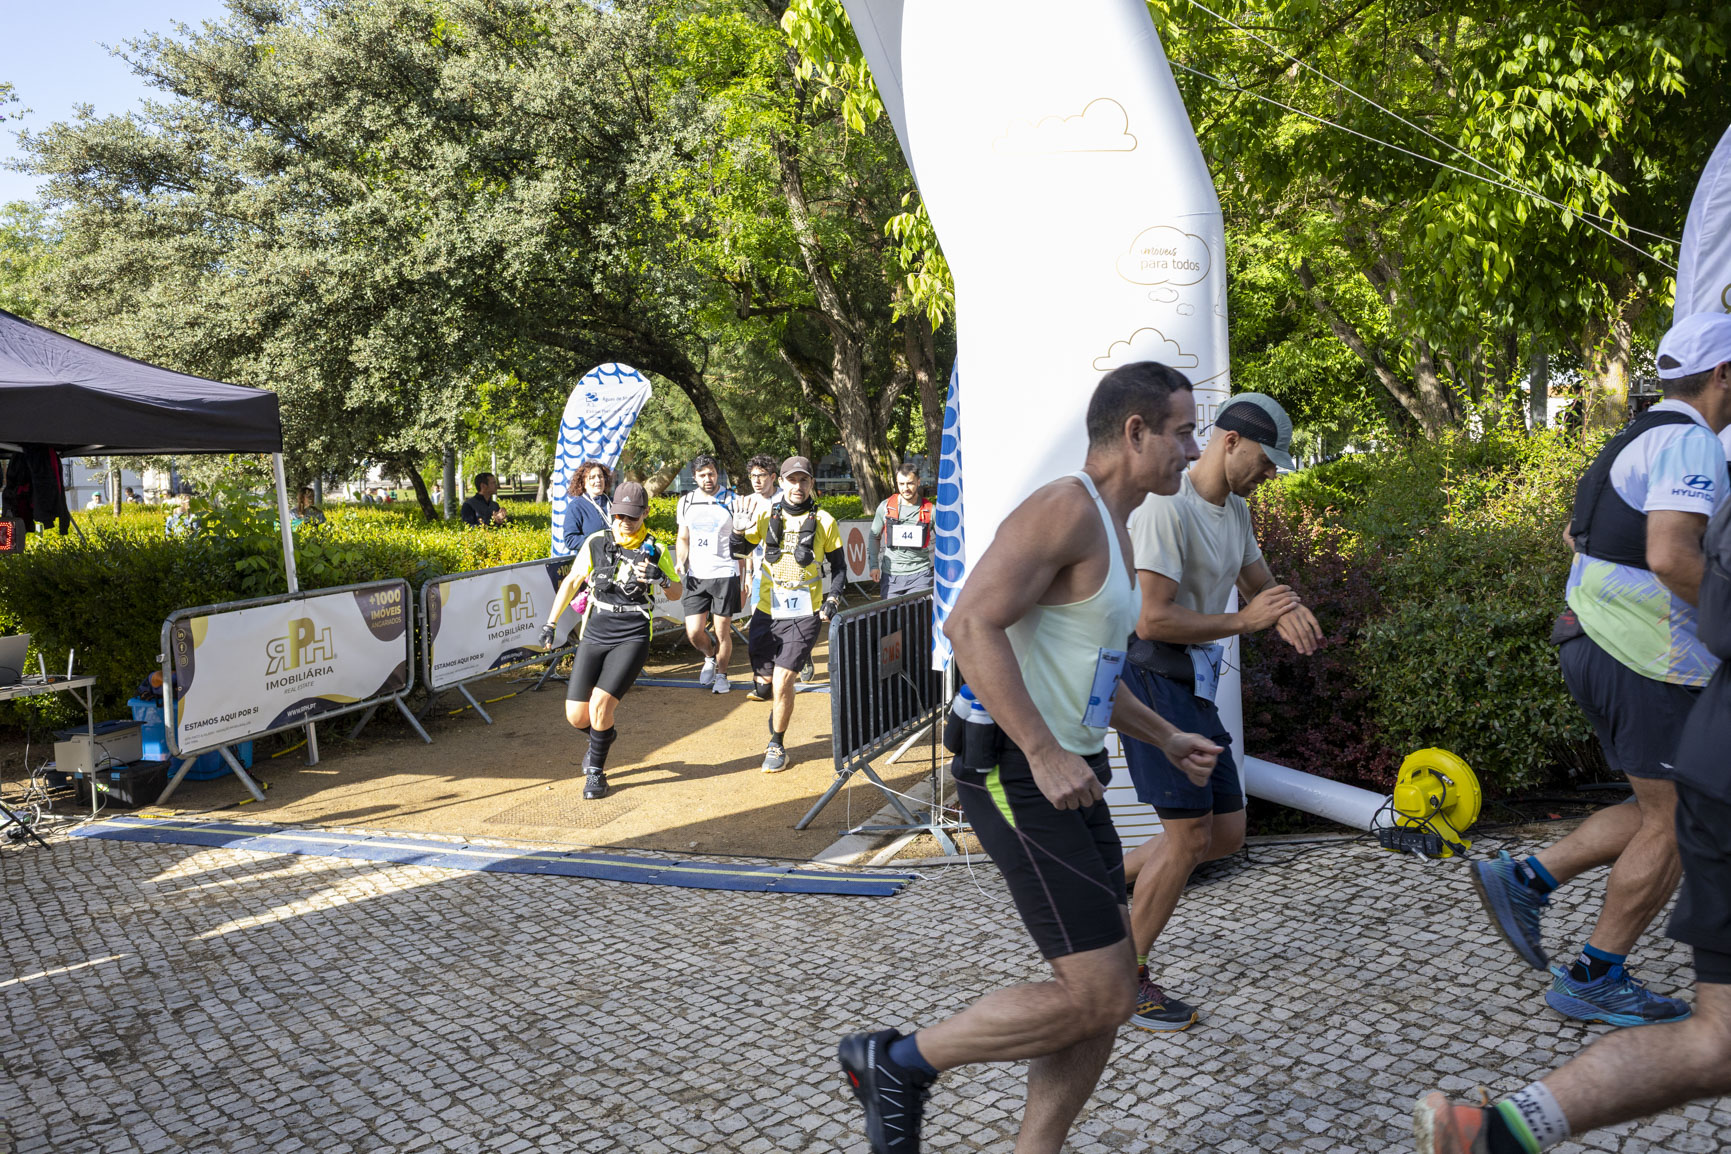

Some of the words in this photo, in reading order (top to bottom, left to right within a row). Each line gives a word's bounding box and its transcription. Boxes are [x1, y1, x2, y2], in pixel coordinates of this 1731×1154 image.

[1141, 259, 1168, 271] para
[1172, 258, 1200, 271] todos
[1671, 488, 1714, 503] HYUND
[697, 538, 709, 548] 24
[901, 531, 913, 540] 44
[848, 542, 864, 563] W
[369, 589, 401, 606] +1000
[784, 597, 798, 609] 17
[371, 605, 402, 620] IMÓVEIS
[487, 622, 535, 641] IMOBILIÁRIA
[882, 642, 900, 665] CMS
[433, 660, 457, 671] ESTAMOS
[457, 656, 470, 665] AQUI
[266, 665, 334, 691] IMOBILIÁRIA
[284, 686, 296, 695] REAL
[297, 680, 315, 691] ESTATE
[184, 716, 219, 732] ESTAMOS
[219, 713, 237, 723] AQUI
[237, 709, 252, 718] POR
[252, 706, 259, 714] SI
